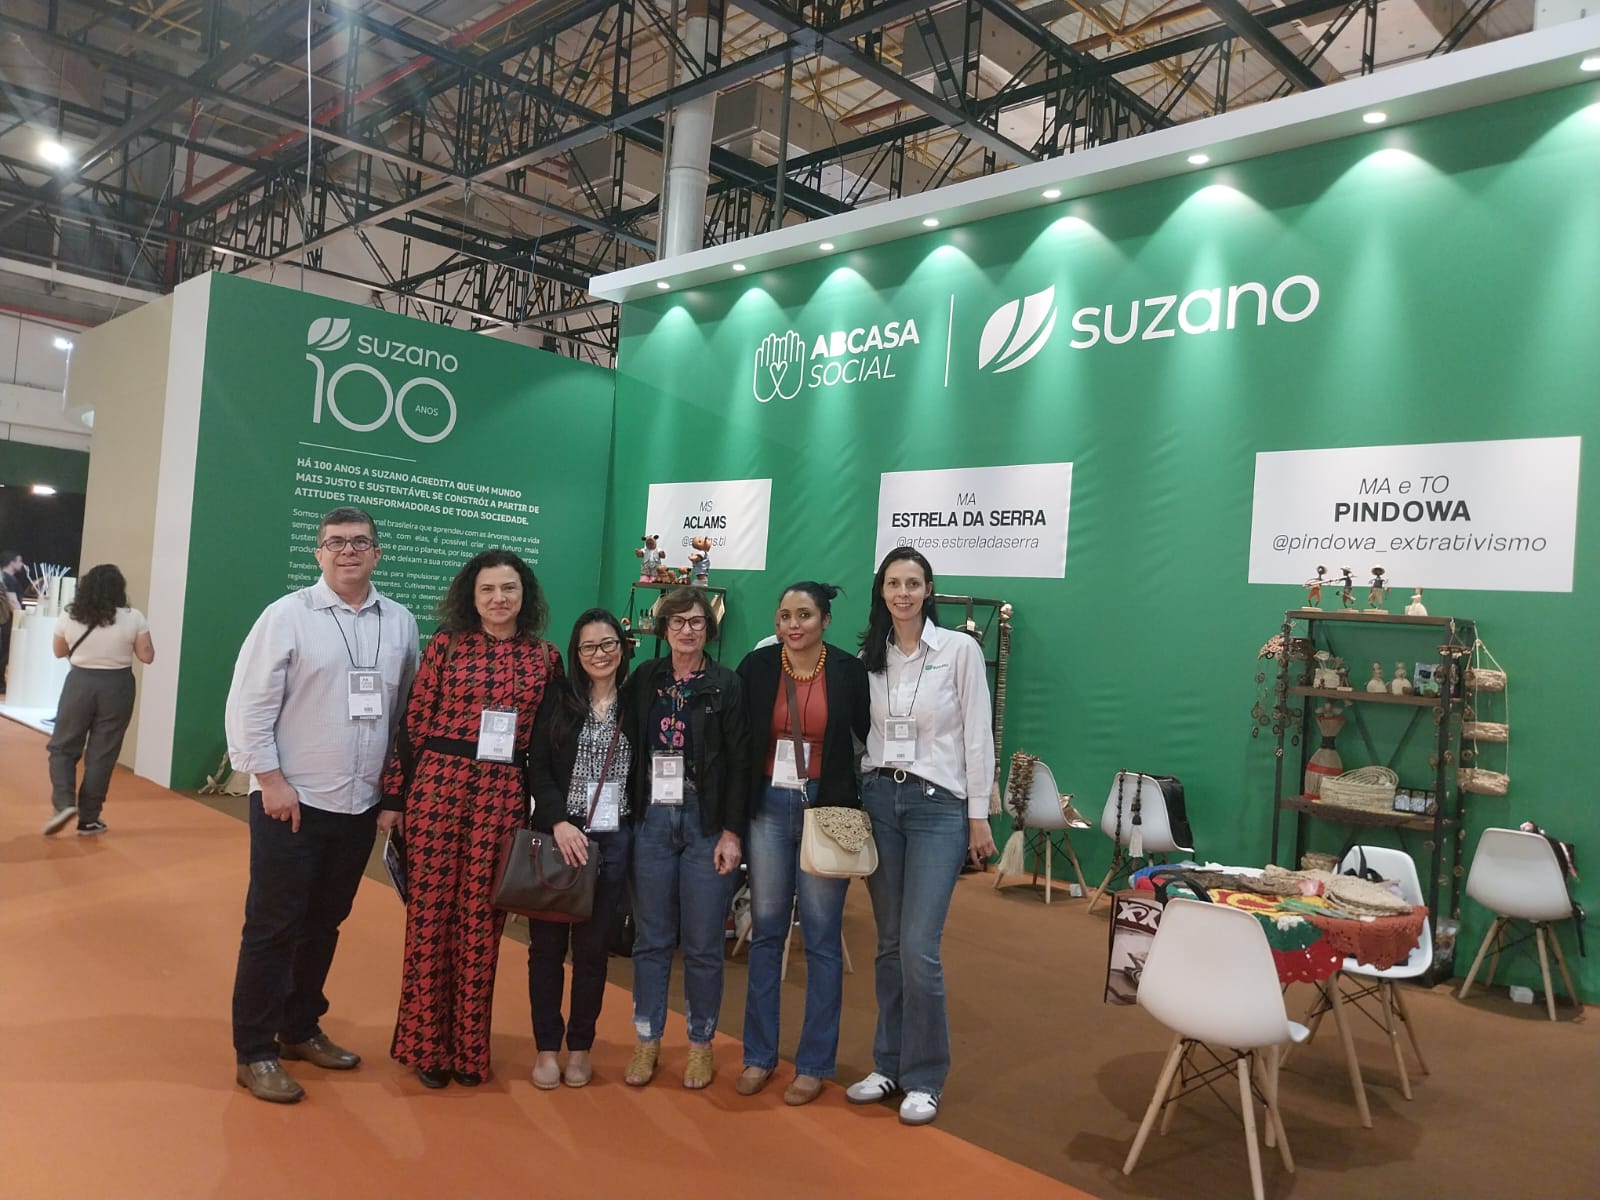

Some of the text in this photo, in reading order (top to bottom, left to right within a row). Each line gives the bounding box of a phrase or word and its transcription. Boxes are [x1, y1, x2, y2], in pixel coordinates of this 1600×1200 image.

[1069, 275, 1320, 349] suzano
[810, 318, 920, 360] ABCASA
[357, 335, 458, 372] suzano
[808, 354, 896, 388] SOCIAL
[306, 353, 457, 443] 100
[415, 405, 438, 416] ANOS
[297, 457, 522, 498] HÁ 100 ANOS A SUZANO ACREDITA QUE UM MUNDO
[1359, 475, 1449, 494] MA e TO
[296, 473, 323, 484] MAIS
[325, 477, 357, 488] JUSTO
[367, 483, 430, 499] SUSTENTÁVEL
[432, 492, 443, 500] SE
[445, 494, 488, 506] CONSTRÓI
[490, 500, 496, 508] A
[498, 501, 527, 512] PARTIR
[529, 506, 540, 514] DE
[956, 492, 977, 506] MA
[294, 487, 529, 525] ATITUDES TRANSFORMADORAS DE TODA SOCIEDADE.
[699, 501, 713, 512] MS
[1334, 500, 1471, 523] PINDOWA
[292, 508, 319, 518] Somos
[387, 520, 418, 530] brasileira
[419, 524, 432, 533] que
[433, 526, 464, 535] aprendeu
[487, 531, 509, 540] árvores
[511, 535, 522, 543] que
[527, 536, 540, 544] vida
[683, 516, 727, 529] ACLAMS
[892, 509, 1047, 528] ESTRELA DA SERRA
[471, 540, 485, 548] criar
[502, 543, 522, 552] futuro
[896, 536, 1039, 549] @artes.estreladaserra
[1272, 533, 1547, 554] @pindowa_extrativismo
[289, 562, 317, 570] Também
[397, 554, 422, 564] deixam
[288, 573, 311, 581] regiões
[404, 582, 436, 590] Cultivamos
